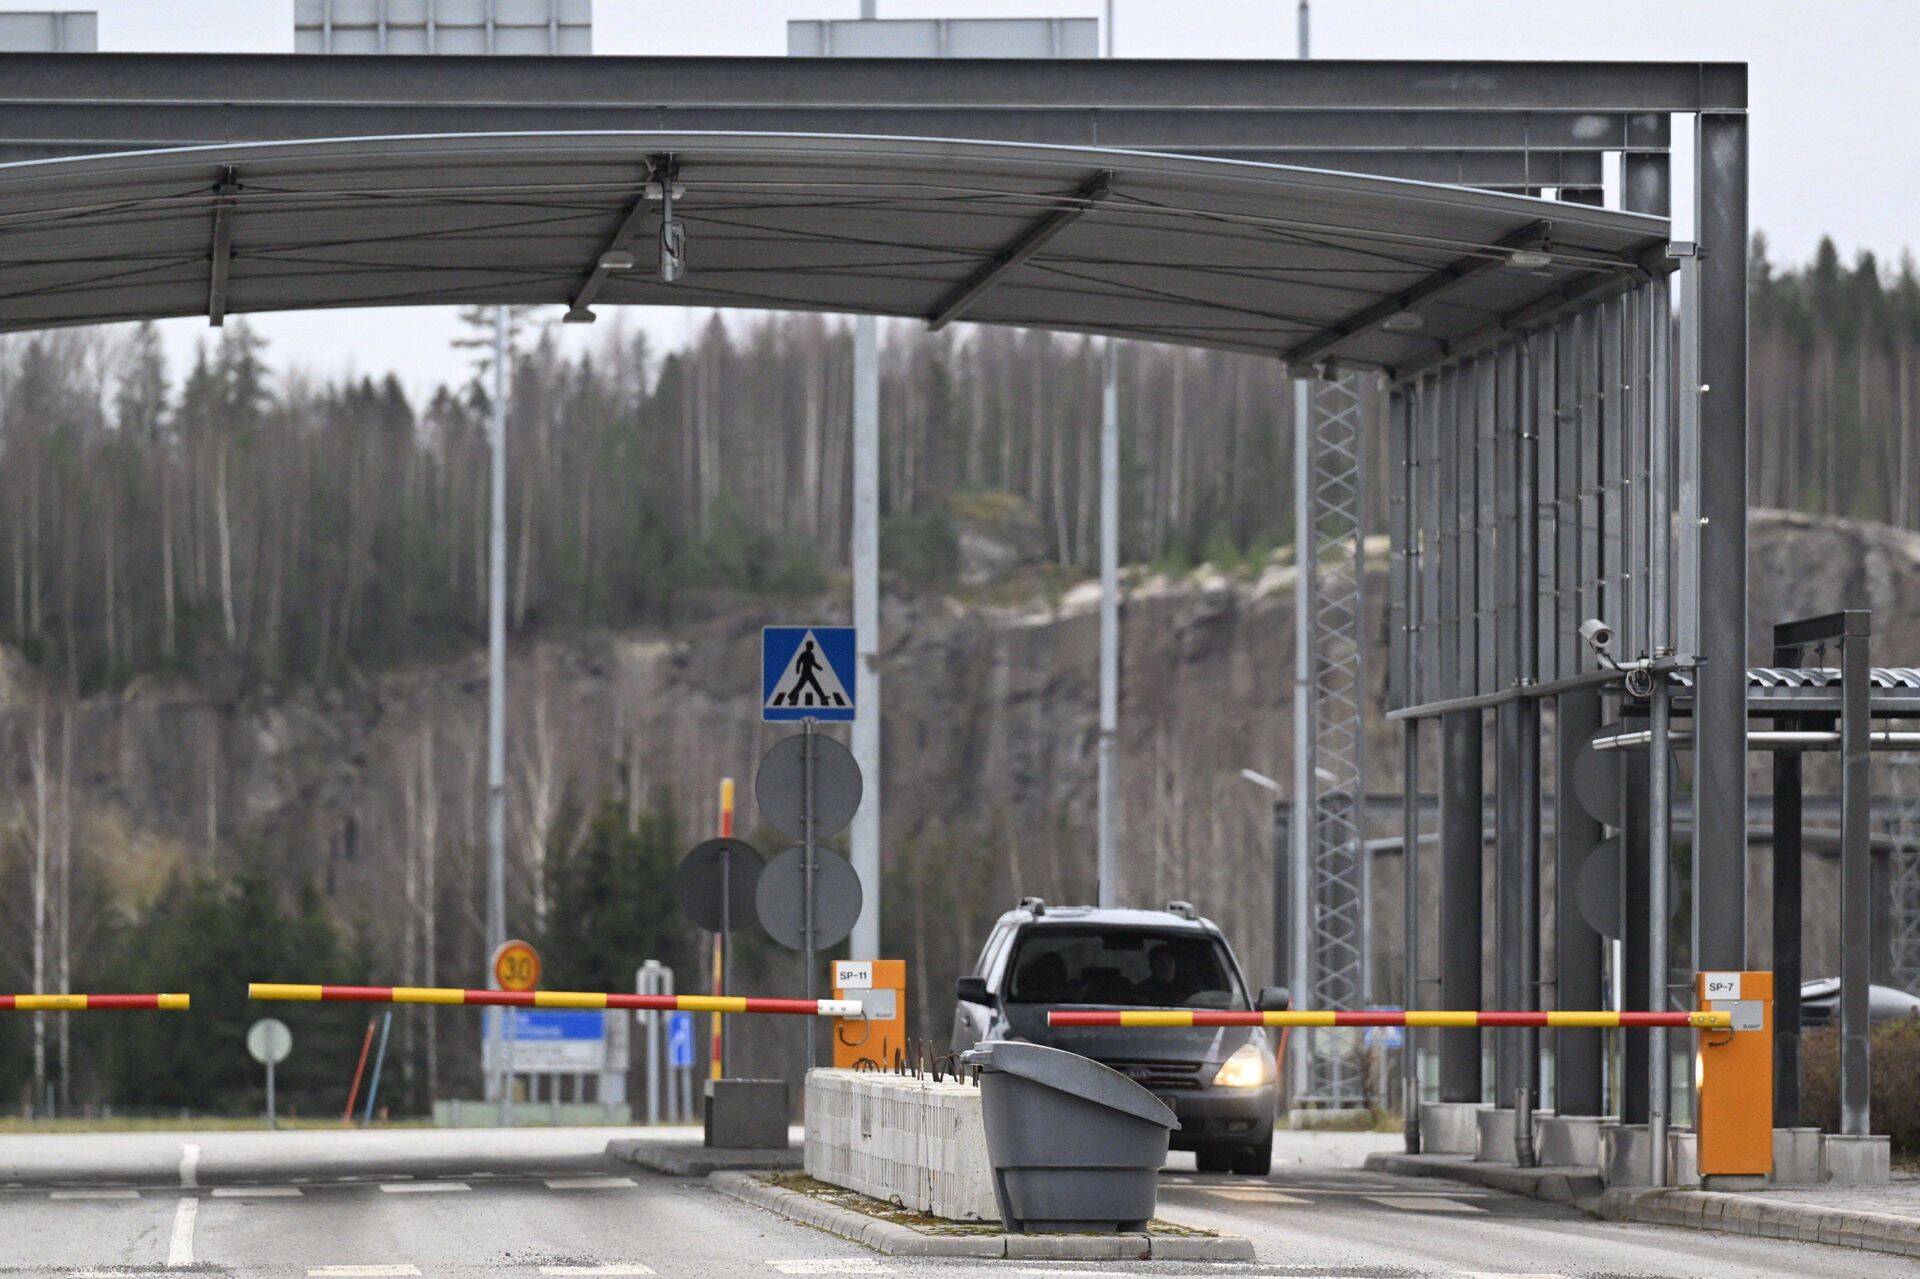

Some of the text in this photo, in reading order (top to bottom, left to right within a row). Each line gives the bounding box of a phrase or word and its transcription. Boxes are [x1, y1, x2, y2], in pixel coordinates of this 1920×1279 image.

[505, 956, 531, 980] 30
[840, 971, 867, 980] SP-11
[1709, 982, 1734, 991] SP-7
